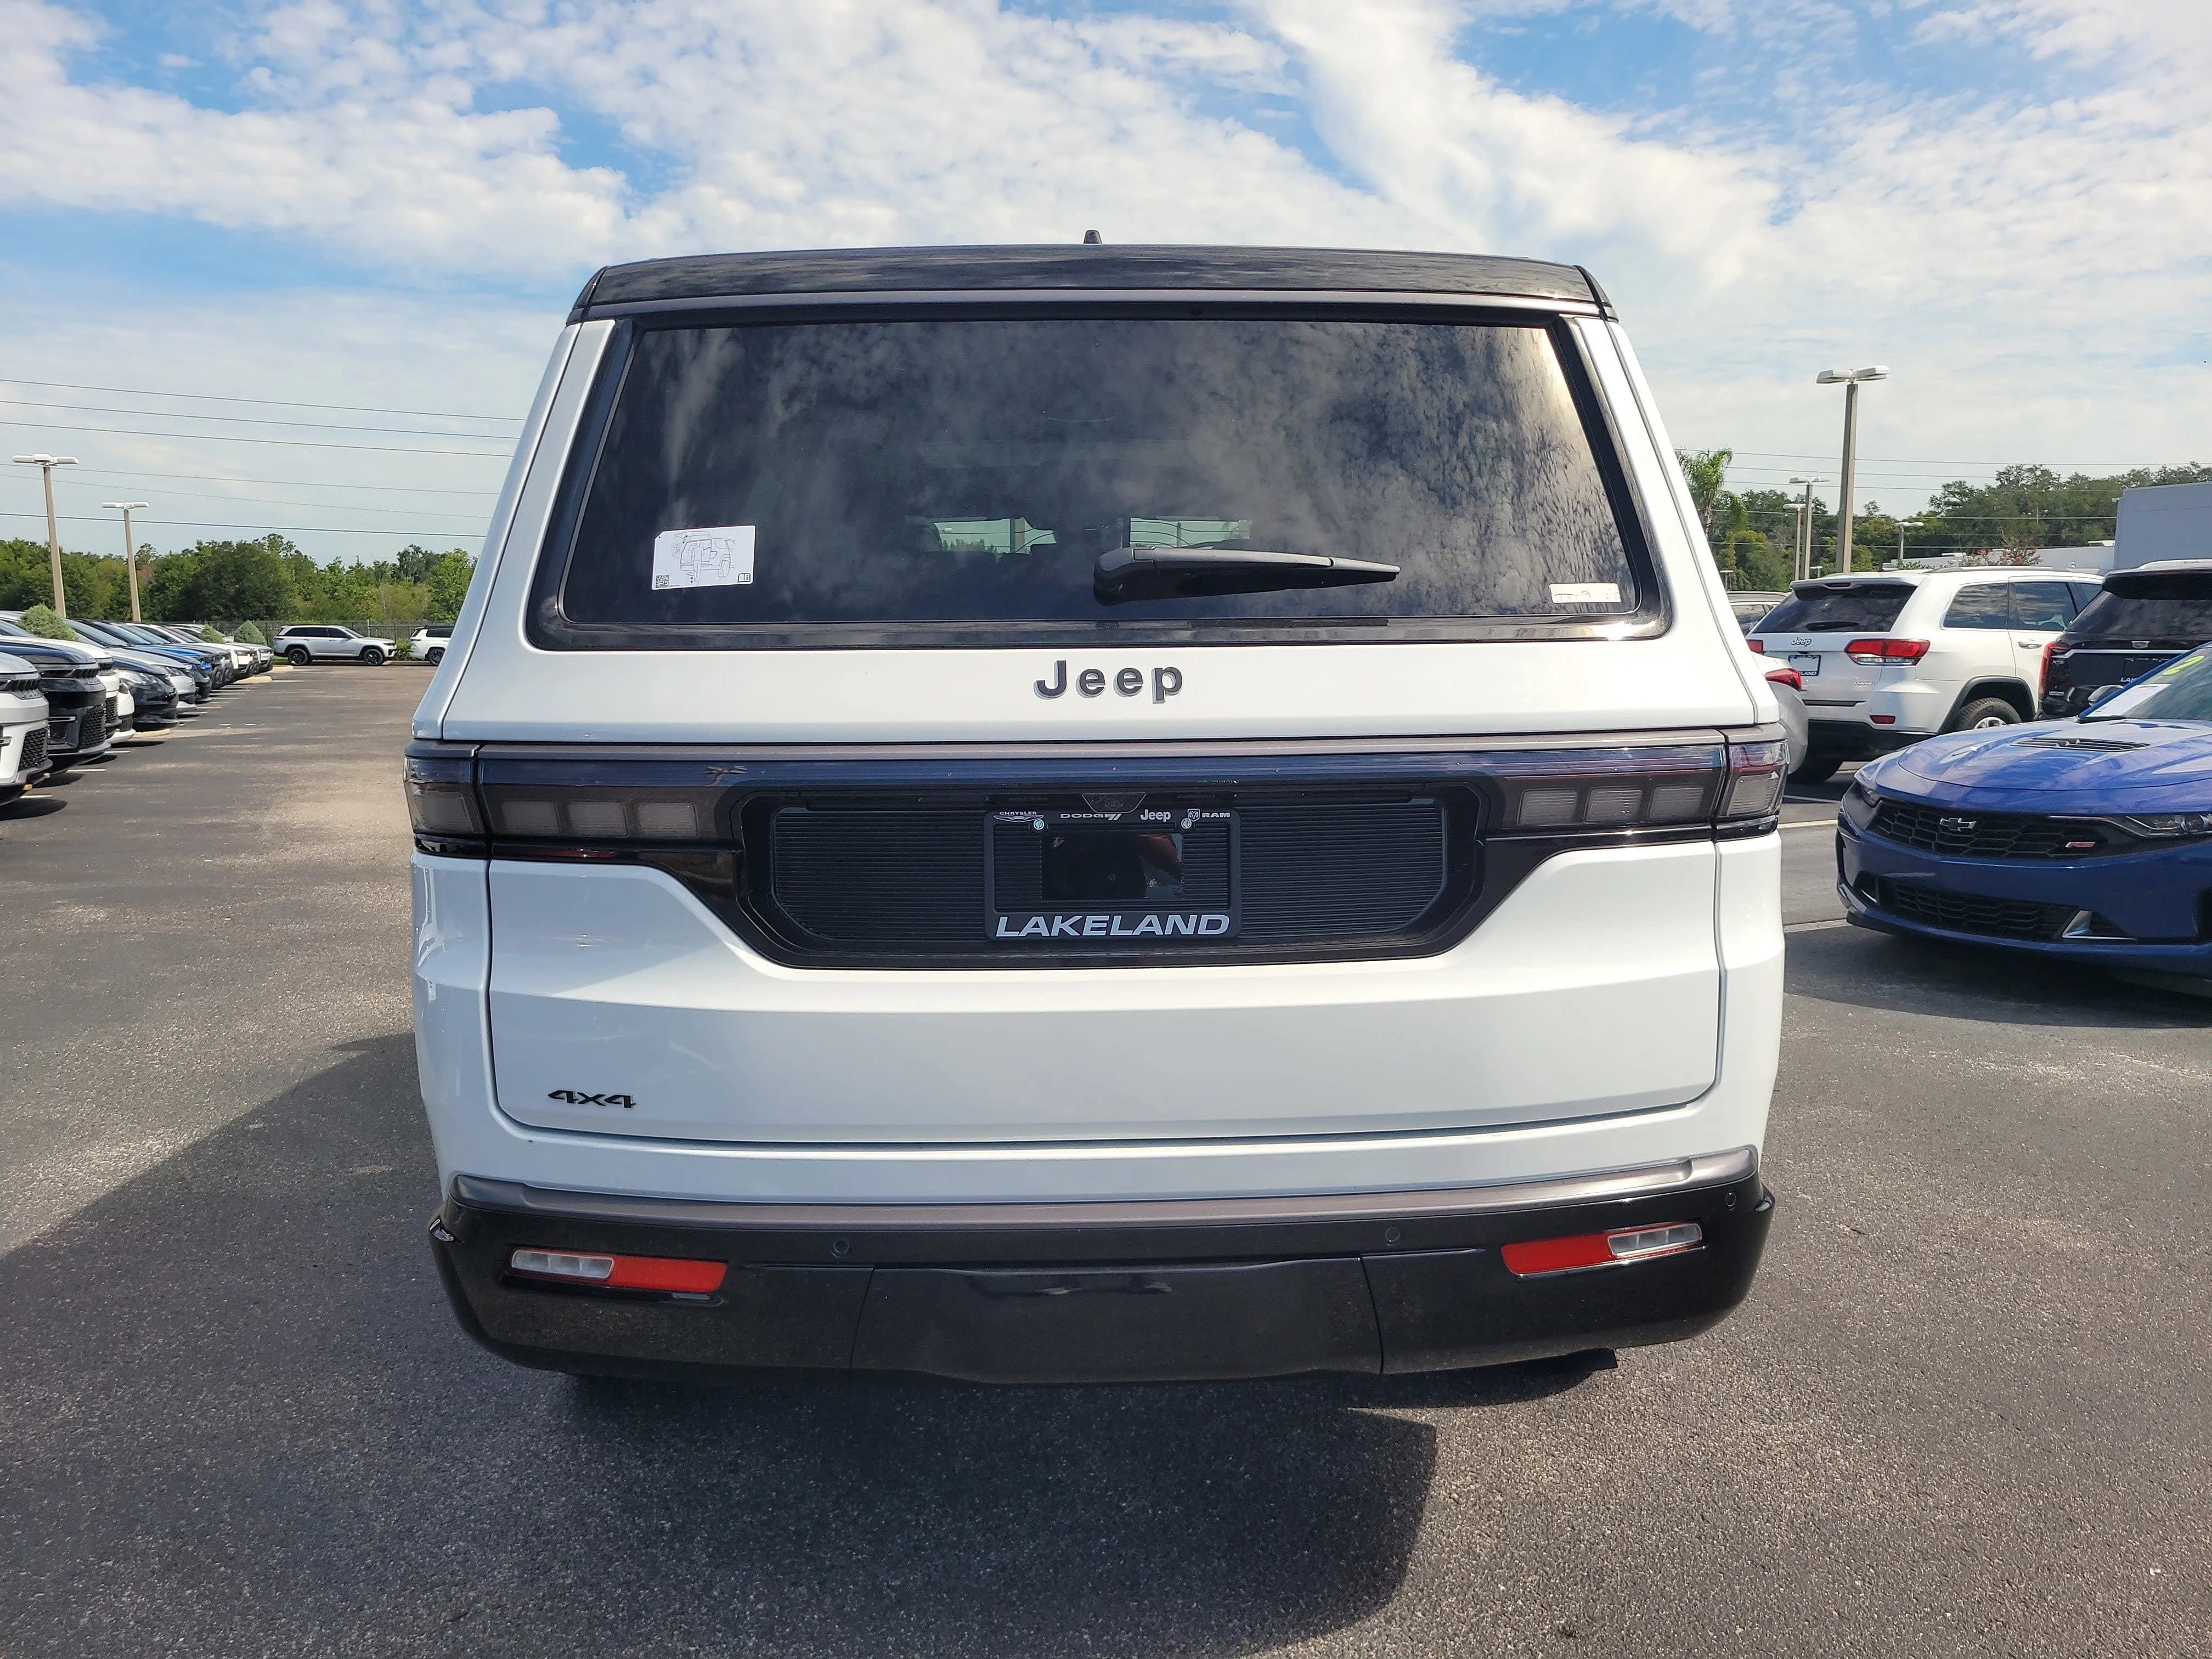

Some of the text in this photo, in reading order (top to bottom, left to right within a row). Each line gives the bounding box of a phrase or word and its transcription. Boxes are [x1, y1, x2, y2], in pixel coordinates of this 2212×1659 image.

[1791, 637, 1812, 647] Jeep
[1034, 660, 1183, 704] Jeep
[1140, 809, 1171, 822] Jeep
[996, 914, 1229, 936] LAKELAND
